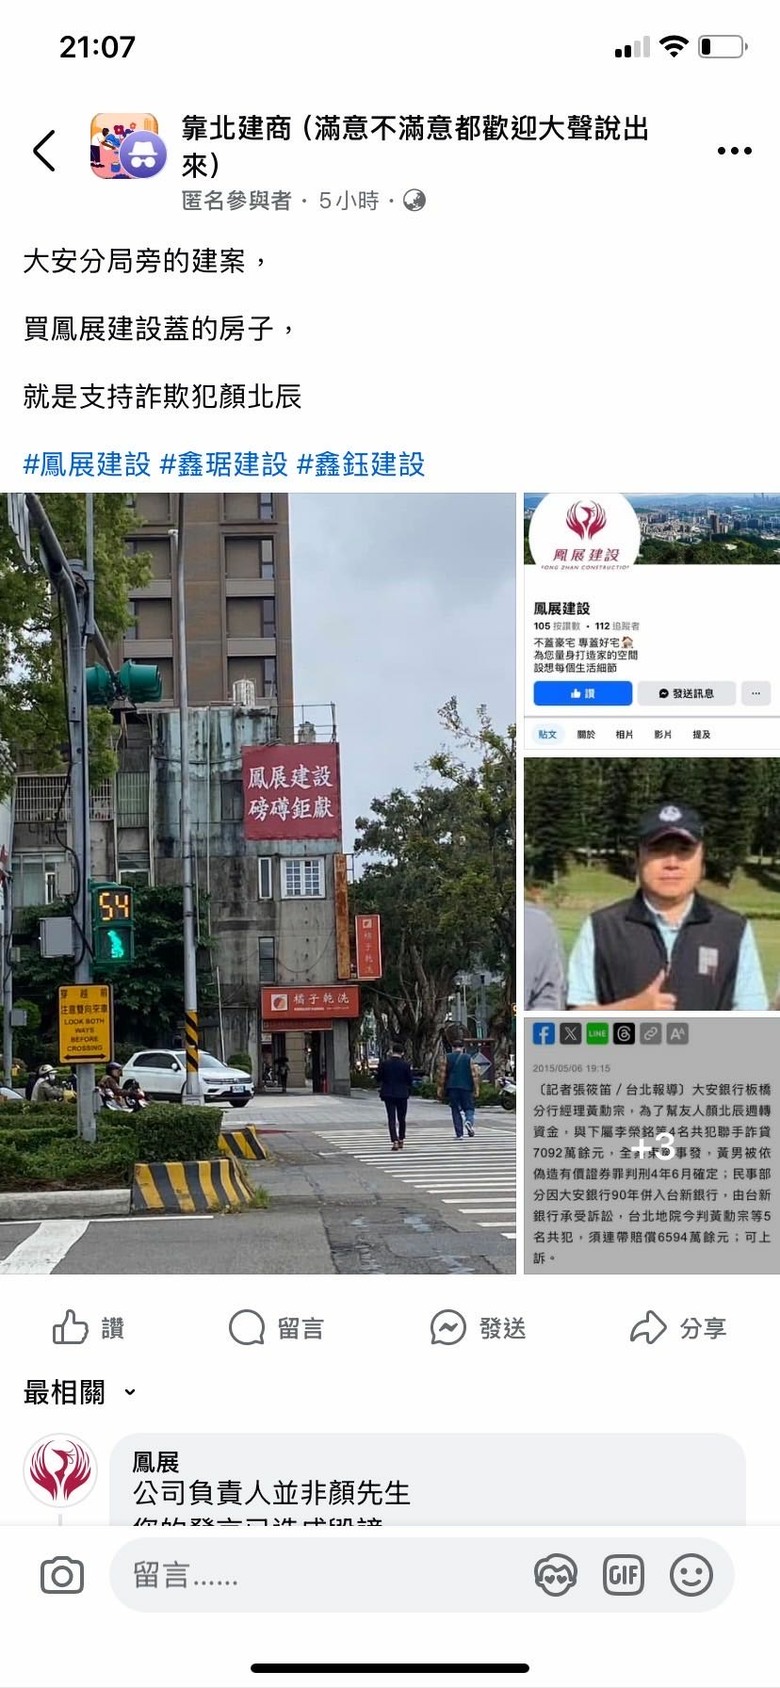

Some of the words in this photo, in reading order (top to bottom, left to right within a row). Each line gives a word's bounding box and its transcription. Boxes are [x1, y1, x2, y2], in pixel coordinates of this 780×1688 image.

[60, 36, 135, 58] 21:07
[182, 115, 291, 141] 靠北建商
[303, 115, 648, 141] (滿意不滿意都歡迎大聲說出
[182, 152, 218, 179] 來)
[182, 190, 291, 211] 匿名參與者
[23, 248, 264, 274] 大安分局旁的建案，
[24, 315, 292, 342] 買鳳展建設蓋的房子，
[23, 383, 302, 410] 就是支持詐欺犯顏北辰
[23, 450, 151, 477] #鳳展建設
[160, 450, 288, 477] #鑫琚建設
[297, 450, 425, 477] #鑫鈺建設
[553, 548, 619, 562] 鳳展建設
[534, 602, 590, 615] 鳳展建設
[534, 622, 550, 630] 105
[595, 622, 610, 630] 112
[534, 637, 576, 648] 不蓋豪宅
[578, 637, 620, 648] 專蓋好宅
[534, 650, 638, 661] 為您量身打造家的空間
[534, 662, 617, 673] 設想每個生活細節
[673, 688, 715, 699] 發送訊息
[538, 729, 557, 740] 貼文
[577, 729, 595, 740] 關於
[616, 729, 633, 740] 相片
[654, 729, 672, 740] 影片
[692, 729, 711, 740] 提及
[248, 763, 334, 790] 鳳展建設
[99, 892, 129, 921] 54
[533, 1064, 583, 1073] 2015/05/06
[586, 1064, 611, 1073] 19:15
[533, 1252, 555, 1264] 訴。
[102, 1317, 125, 1340] 讚
[278, 1317, 325, 1340] 留言
[479, 1317, 526, 1340] 發送
[680, 1317, 727, 1340] 分享
[24, 1378, 106, 1406] 最相關
[133, 1451, 179, 1474] 鳳展
[133, 1480, 411, 1506] 公司負責人並非顏先生
[609, 1564, 638, 1587] GIF
